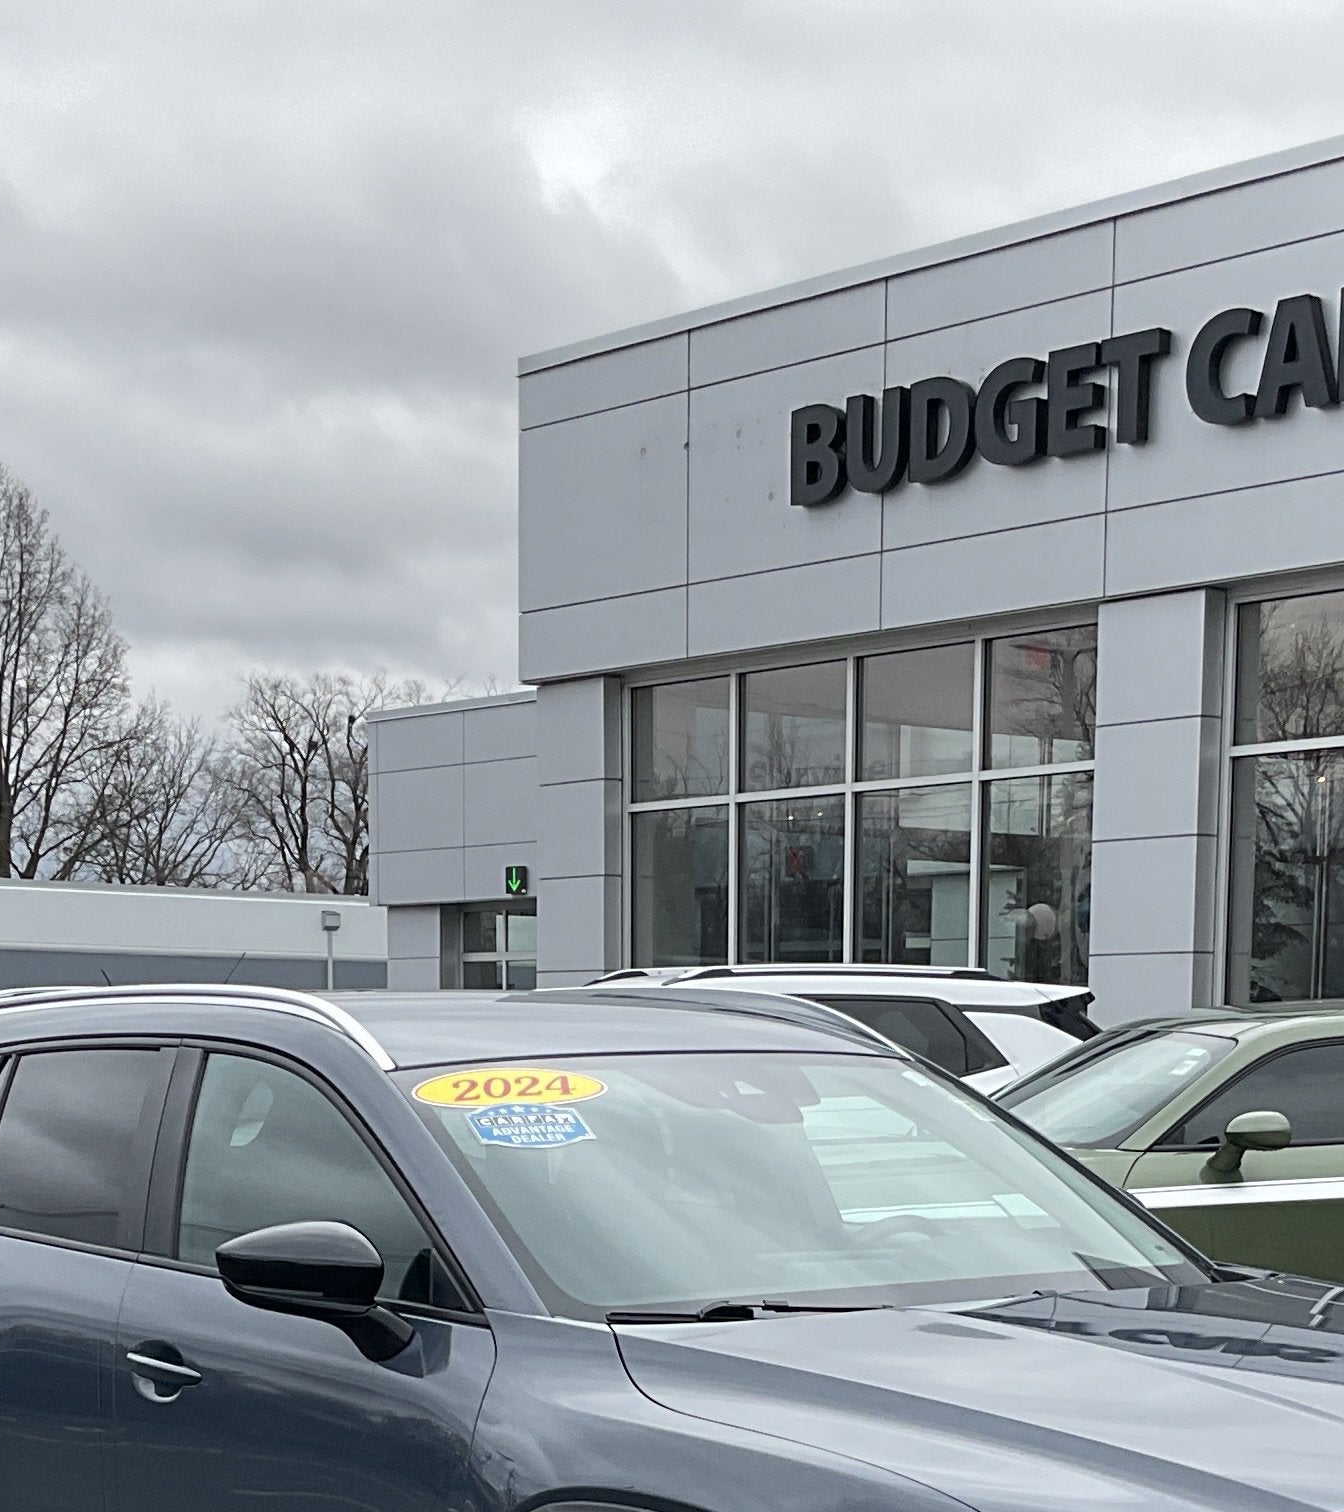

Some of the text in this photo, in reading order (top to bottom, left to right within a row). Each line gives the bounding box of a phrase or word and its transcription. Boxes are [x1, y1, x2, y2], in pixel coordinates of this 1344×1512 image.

[790, 327, 1171, 507] BUDGET
[452, 1075, 576, 1102] 2024
[477, 1114, 575, 1127] CARFAX
[492, 1124, 575, 1137] ADVANTAGE
[511, 1133, 567, 1144] DEALER
